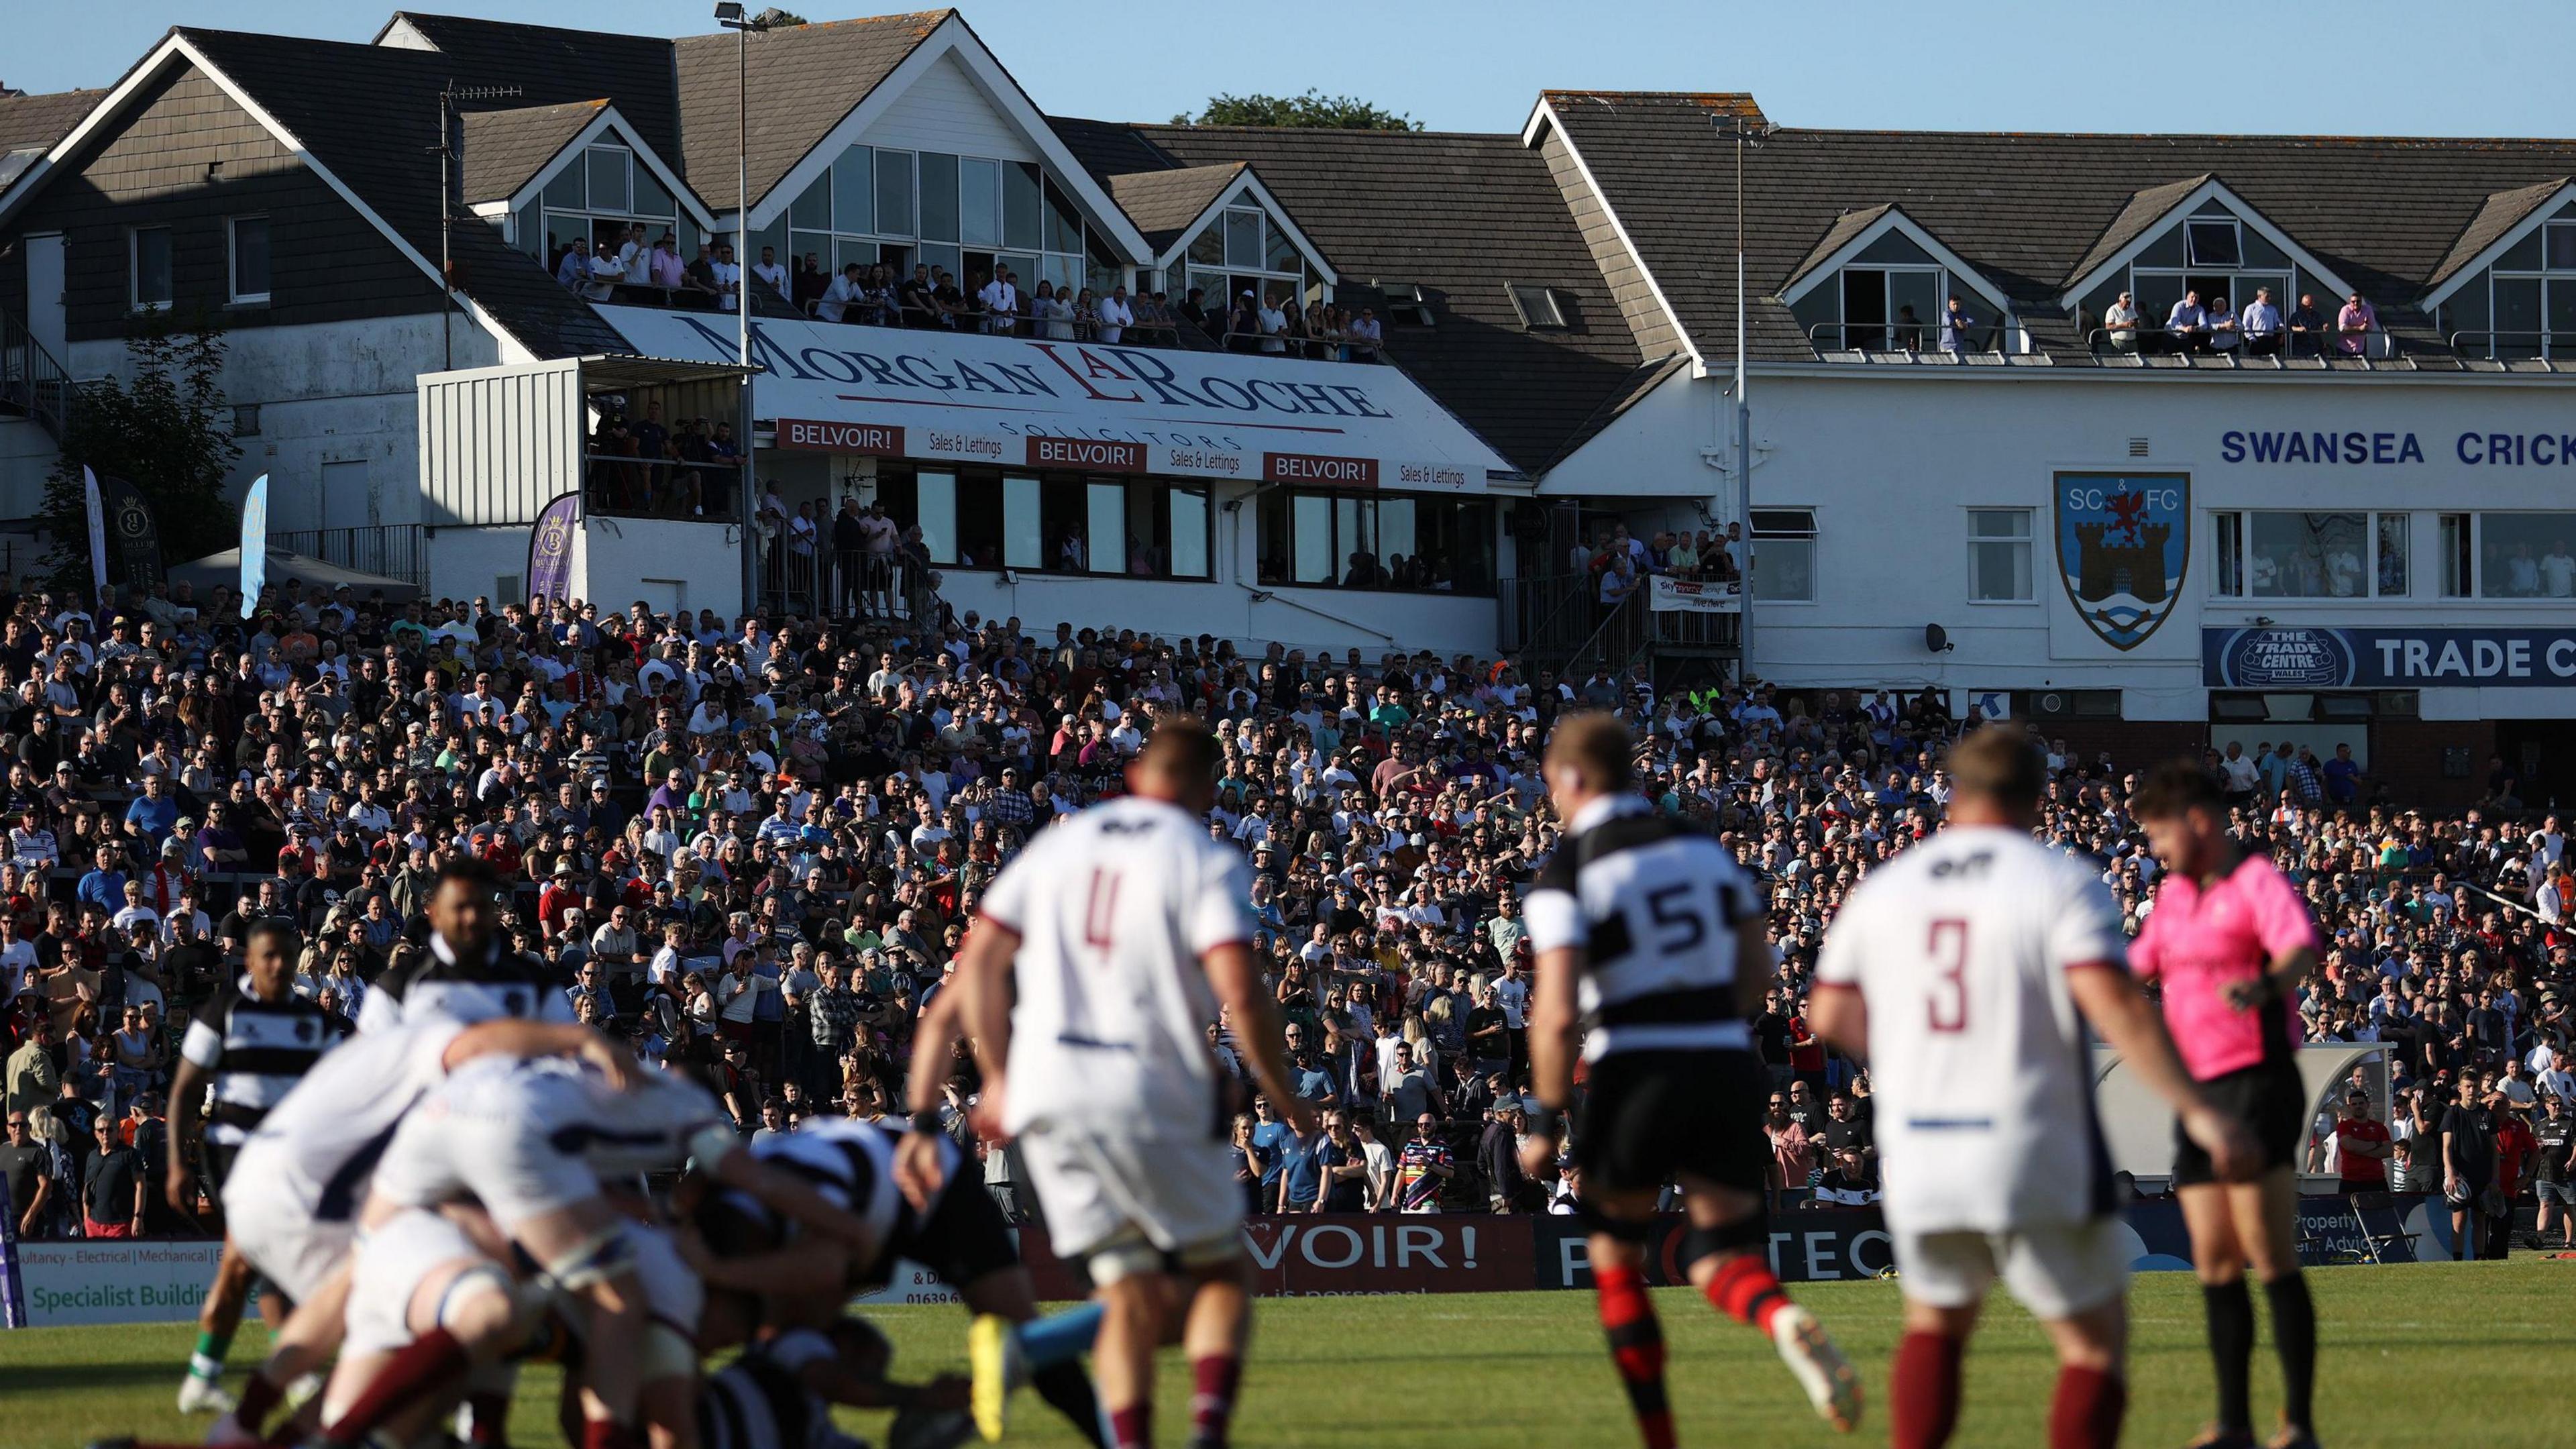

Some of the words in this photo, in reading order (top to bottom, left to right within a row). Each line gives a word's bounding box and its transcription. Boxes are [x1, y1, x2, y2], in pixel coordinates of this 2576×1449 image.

[672, 317, 1059, 398] MORGAN
[791, 425, 892, 449] BELVOIR!
[930, 433, 953, 451] Sales
[955, 435, 962, 451] &
[965, 436, 1002, 459] Lettings
[999, 422, 1242, 451] SOLICITORS
[2222, 431, 2424, 464] SWANSEA
[1040, 441, 1134, 466] BELVOIR!
[1171, 449, 1193, 468] Sales
[1195, 451, 1201, 468] &
[1205, 452, 1240, 474] Lettings
[1276, 458, 1366, 481] BELVOIR!
[1401, 465, 1421, 482] Sales
[1424, 466, 1430, 483] &
[1432, 467, 1464, 489] Lettings
[2069, 488, 2103, 511] SC
[2118, 478, 2127, 492] &
[2255, 643, 2321, 653] TRADE
[2269, 632, 2307, 641] THE
[2261, 654, 2316, 668] CENTRE
[2375, 639, 2531, 677] TRADE
[2274, 669, 2303, 678] WALES
[1648, 881, 1705, 955] 5
[1927, 920, 1967, 1032] 3
[76, 1249, 131, 1264] Electrical
[139, 1248, 207, 1263] Mechanical
[914, 1272, 923, 1285] &
[34, 1284, 134, 1313] Specialist
[907, 1293, 947, 1305] 01639
